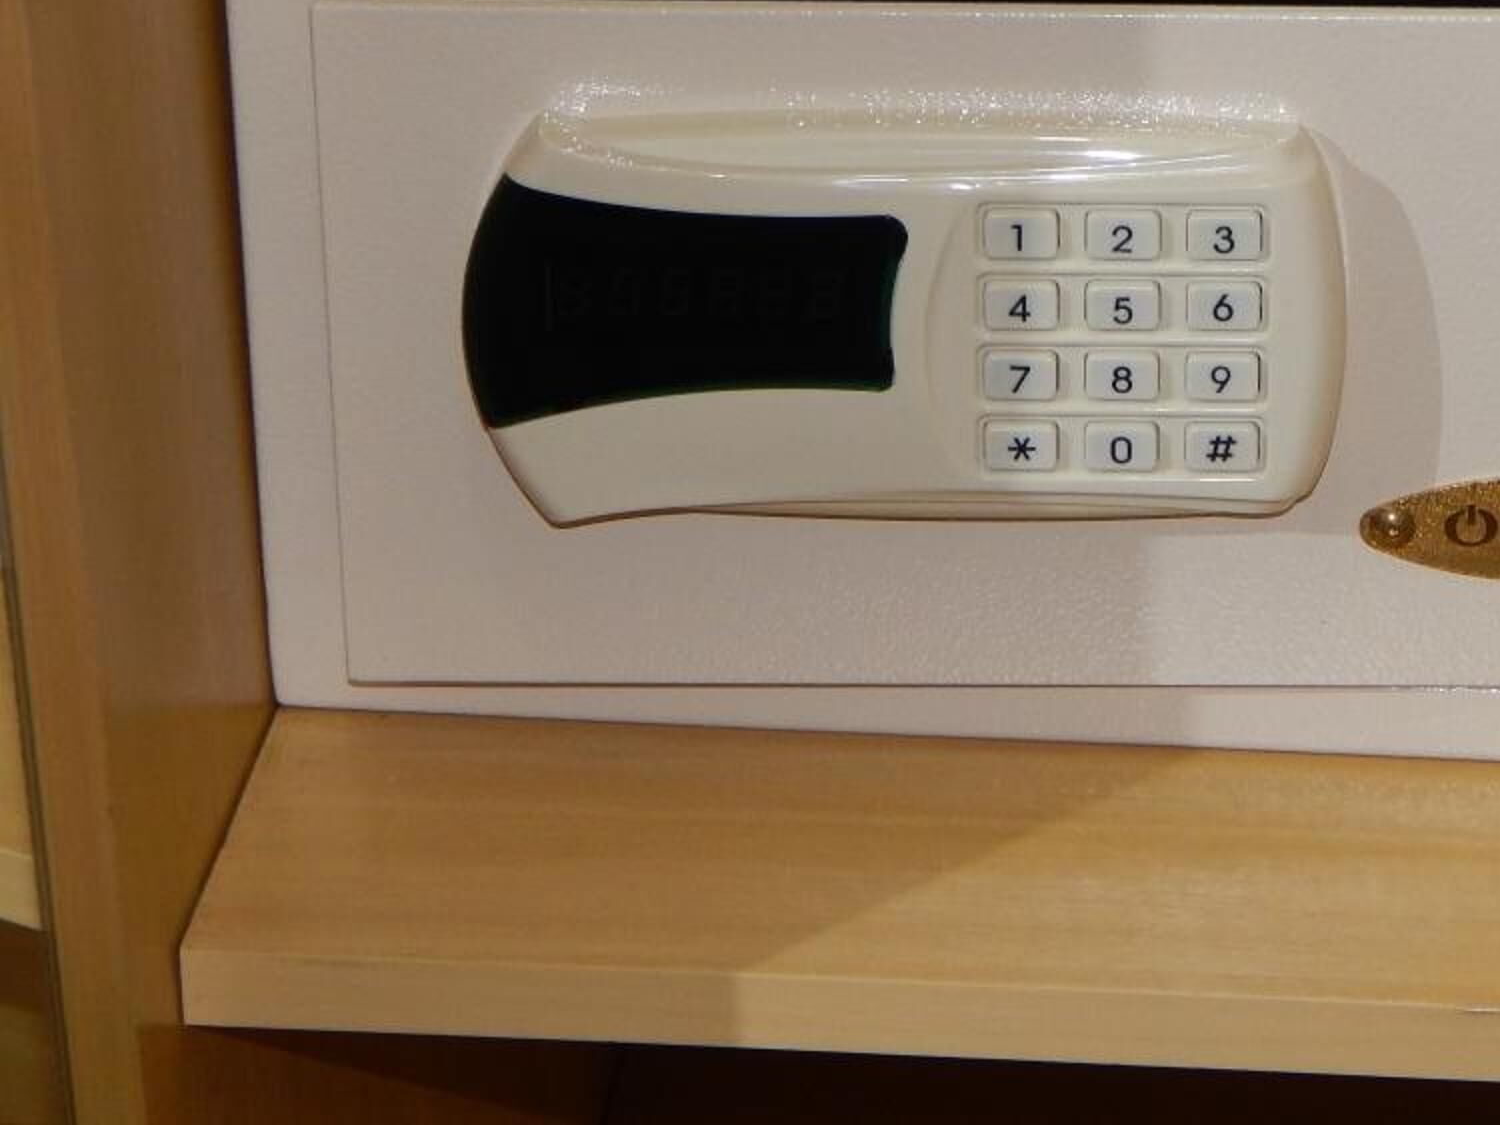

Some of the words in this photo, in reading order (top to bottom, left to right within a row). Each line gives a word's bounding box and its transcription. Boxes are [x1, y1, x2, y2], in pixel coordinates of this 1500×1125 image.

[1011, 225, 1022, 251] 1
[1112, 225, 1133, 253] 2
[1213, 226, 1235, 254] 3
[1009, 295, 1031, 322] 4
[1113, 297, 1133, 324] 5
[1213, 294, 1234, 322] 6
[1009, 365, 1031, 393] 7
[1111, 366, 1133, 394] 8
[1211, 366, 1231, 393] 9
[1111, 436, 1132, 463] 0
[1206, 435, 1237, 462] #
